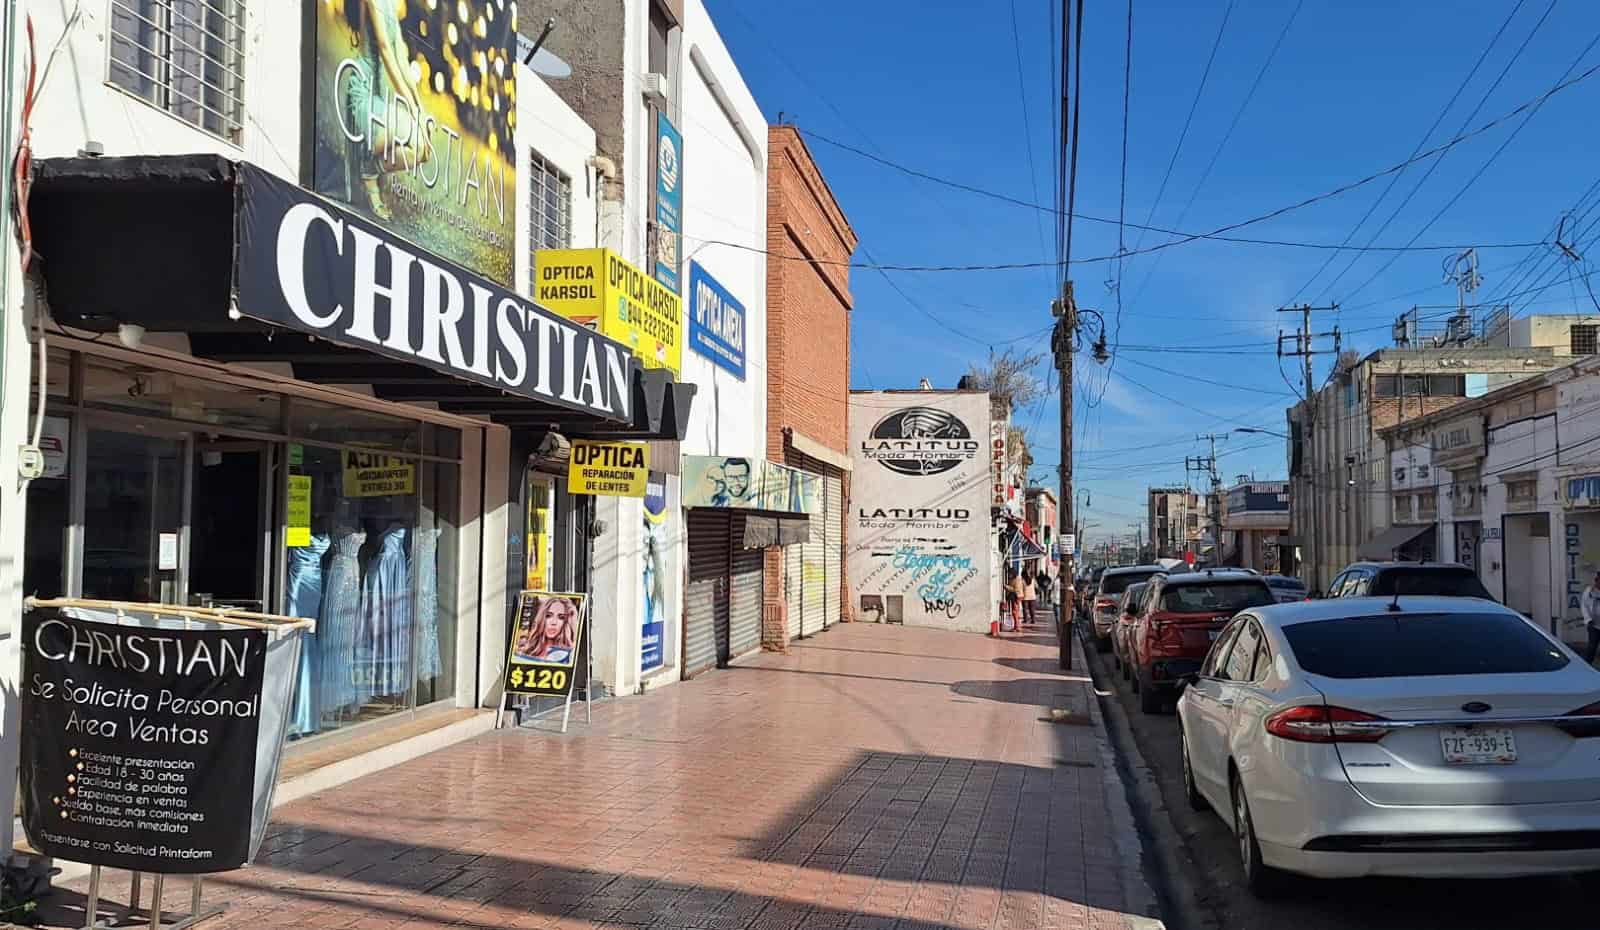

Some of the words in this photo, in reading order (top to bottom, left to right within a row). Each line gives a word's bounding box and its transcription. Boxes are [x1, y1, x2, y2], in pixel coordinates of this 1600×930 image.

[334, 58, 504, 225] CHRISTIAN
[543, 266, 594, 280] OPTICA
[540, 286, 596, 300] KARSOL
[609, 256, 645, 304] OPTICA
[648, 283, 679, 325] KARSOL
[276, 203, 632, 417] CHRISTIAN
[628, 300, 642, 329] 844
[644, 312, 674, 347] 2227539
[574, 444, 646, 469] OPTICA
[862, 440, 979, 450] LATITUD
[864, 451, 906, 459] Moda
[911, 451, 976, 460] Hombre
[993, 439, 1004, 504] OPTICA
[586, 481, 598, 491] DE
[598, 482, 630, 492] LENTES
[860, 508, 970, 519] LATITUD
[905, 521, 960, 529] Hombre
[1567, 524, 1580, 608] OPTICA
[878, 566, 906, 592] LATITU
[35, 620, 249, 677] CHRISTIAN
[510, 666, 566, 690] $120
[32, 673, 55, 699] Se
[63, 678, 149, 712] Solicita
[157, 690, 258, 718] Personal
[65, 710, 118, 738] Area
[128, 716, 210, 746] Ventas
[1444, 737, 1514, 754] FZF-939-E
[80, 748, 122, 766] Excelente
[124, 756, 194, 770] presentación
[76, 774, 121, 791] Facilidad
[124, 780, 138, 792] de
[142, 782, 188, 796] palabra
[86, 764, 112, 776] Edad
[115, 766, 128, 778] 18
[140, 769, 154, 780] 30
[158, 770, 184, 782] años
[77, 786, 133, 804] Experiencia
[136, 795, 150, 804] en
[154, 796, 188, 808] ventas
[62, 797, 94, 812] Sueldo
[150, 808, 204, 822] comisiones
[70, 812, 134, 828] Contratación
[40, 829, 90, 849] Presentarse
[92, 840, 111, 850] con
[114, 841, 157, 857] Solicitud
[160, 846, 212, 860] Printaform
